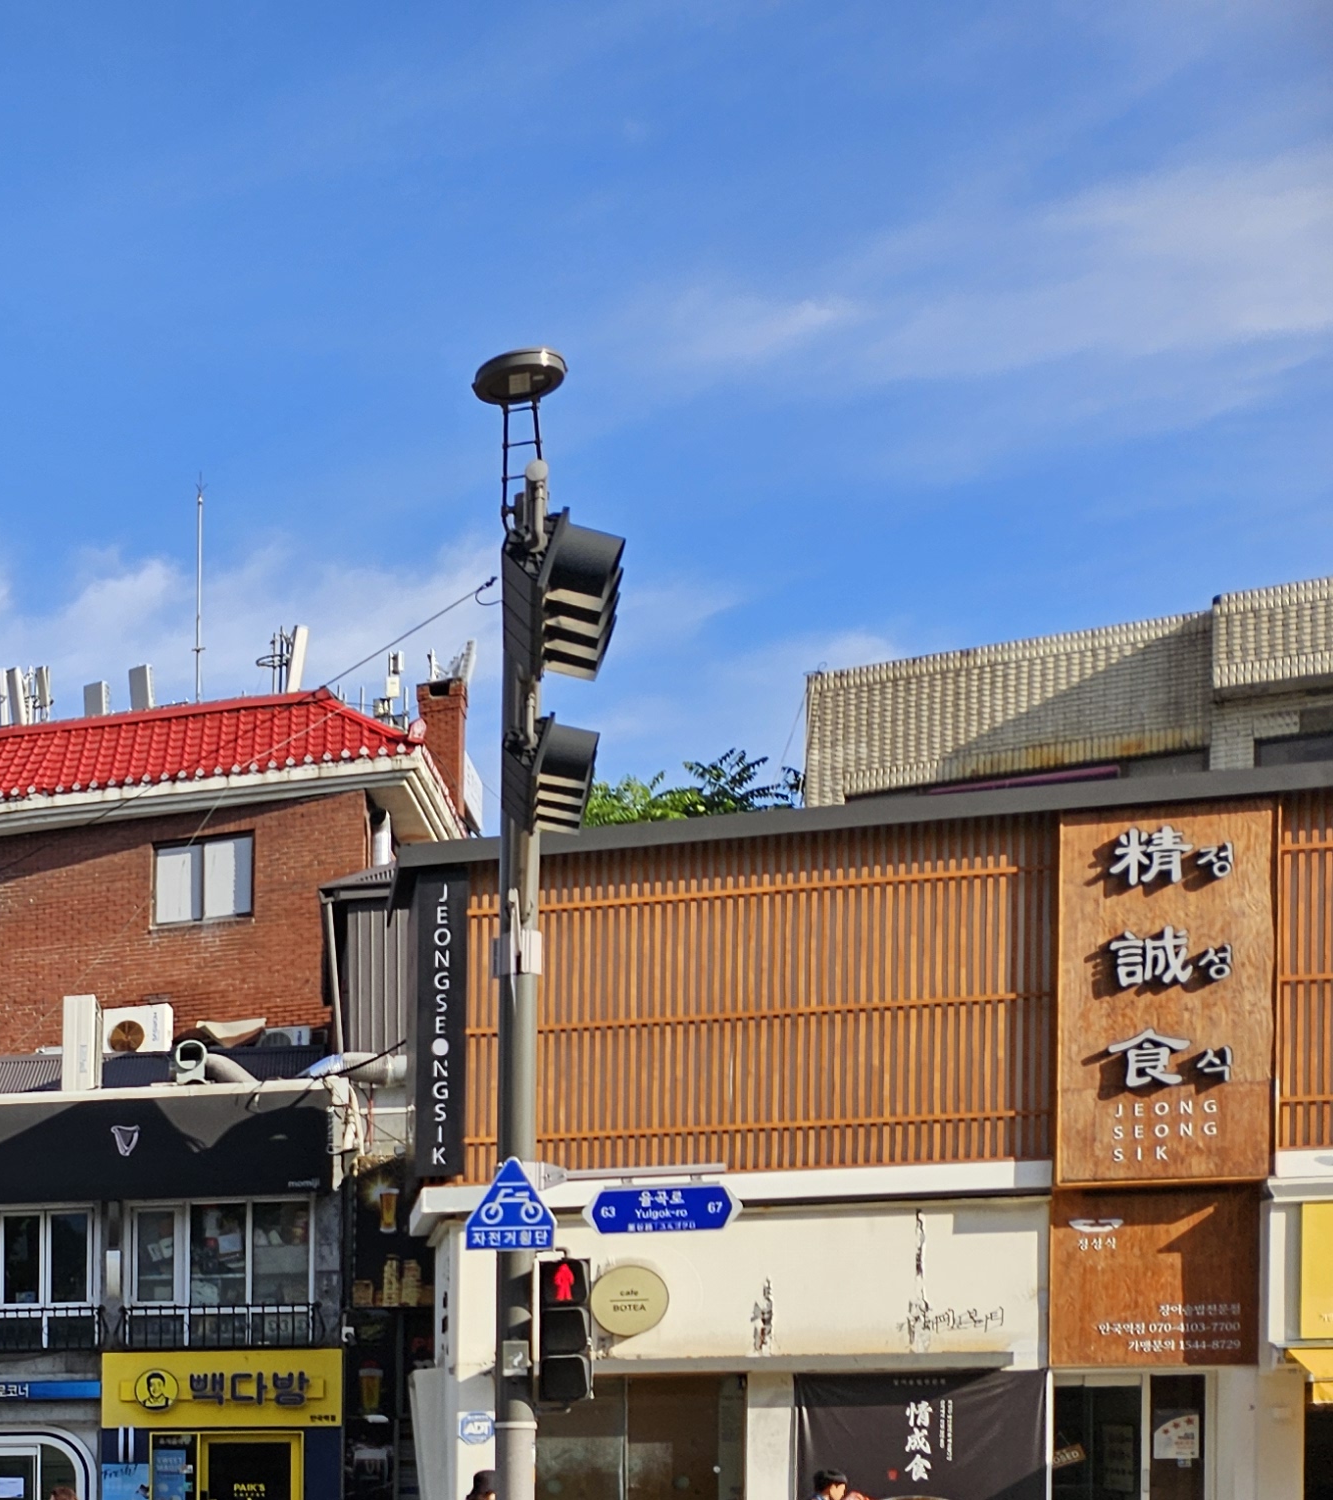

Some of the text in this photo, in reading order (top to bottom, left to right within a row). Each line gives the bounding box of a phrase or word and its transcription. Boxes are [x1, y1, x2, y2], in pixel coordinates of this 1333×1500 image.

[1108, 825, 1193, 1088] 精誠食
[1196, 842, 1233, 1082] 정성식
[1114, 1100, 1218, 1117] JEONG
[1113, 1122, 1218, 1139] SEONG
[1113, 1146, 1169, 1162] SIK
[601, 1190, 723, 1219] 63 율곡로 67
[635, 1208, 688, 1220] Yulgok-ro
[472, 1229, 549, 1246] 자전거횡단
[1077, 1237, 1117, 1250] 정성식
[619, 1288, 639, 1297] cafe
[613, 1304, 647, 1312] BOTEA
[1149, 1322, 1241, 1333] 070-4103-7700
[1179, 1339, 1241, 1350] 1544-8729
[190, 1371, 310, 1406] 빽다방
[464, 1423, 493, 1435] ADT
[234, 1483, 266, 1491] PAIK'S
